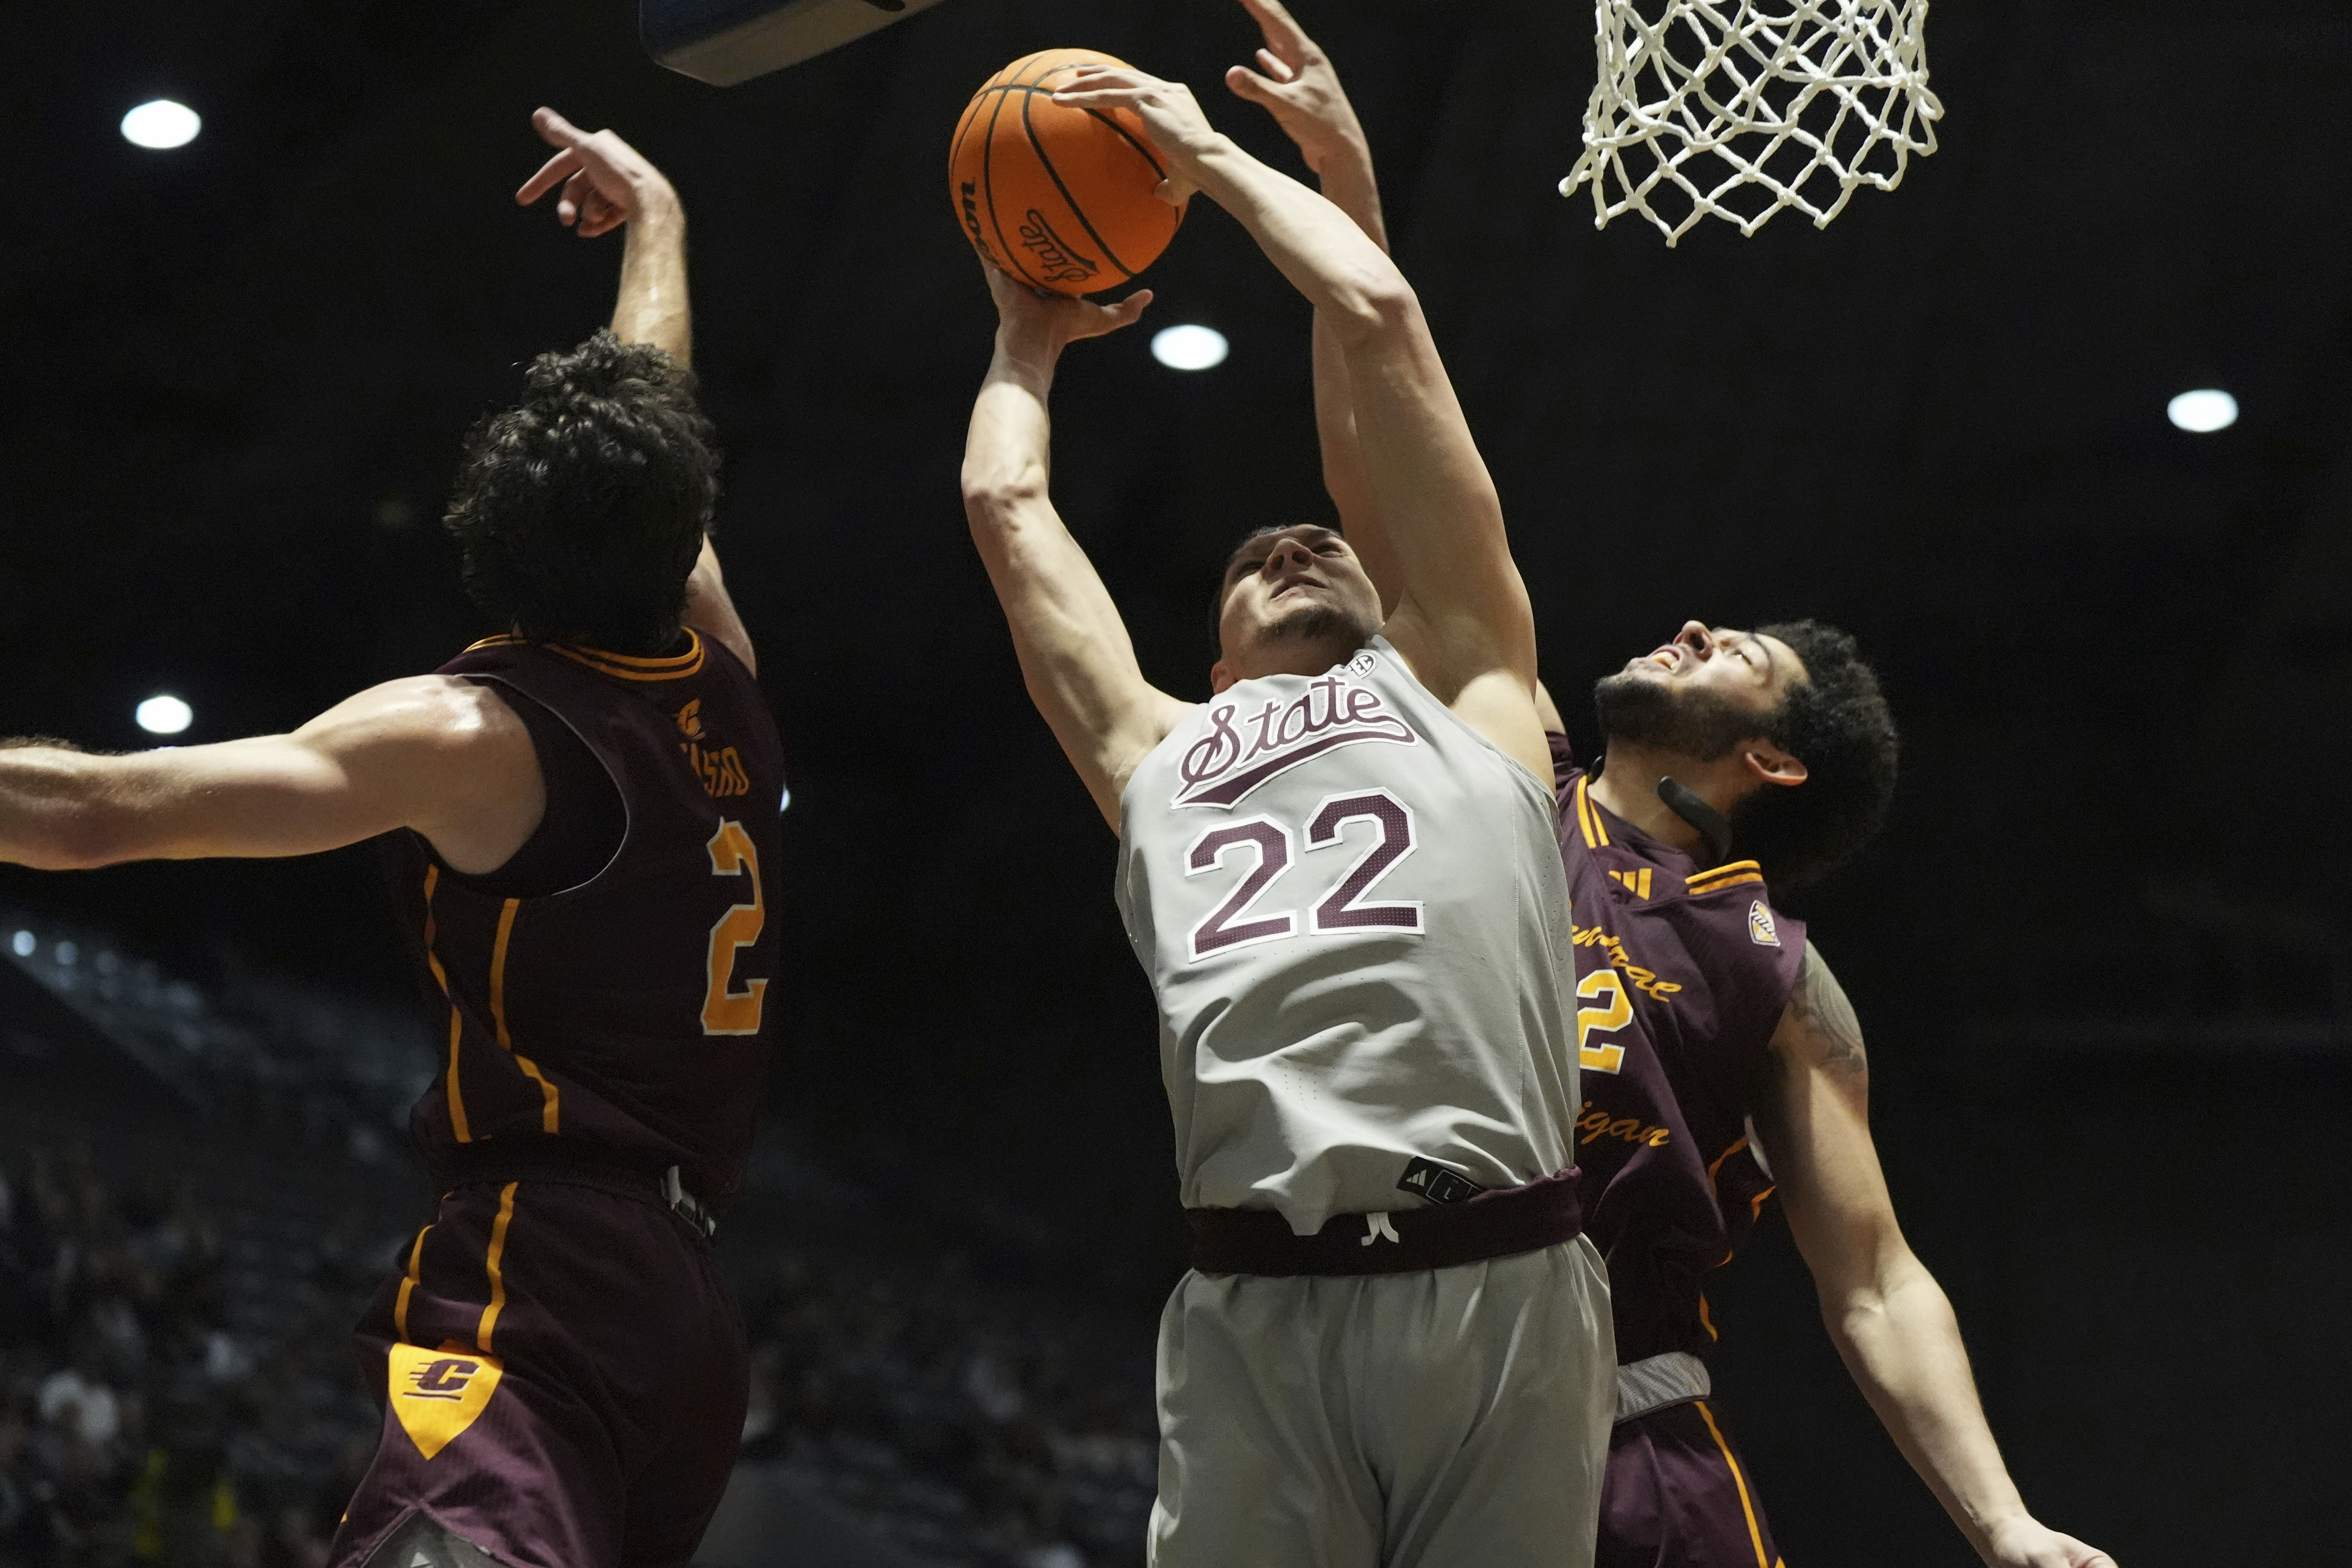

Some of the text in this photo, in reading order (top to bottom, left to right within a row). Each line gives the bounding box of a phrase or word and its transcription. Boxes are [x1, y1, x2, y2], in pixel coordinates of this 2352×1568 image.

[1018, 208, 1098, 283] State
[1170, 675, 1419, 810] State
[700, 817, 769, 1035] 2
[1184, 786, 1425, 964] 22
[1575, 1101, 1670, 1147] igan
